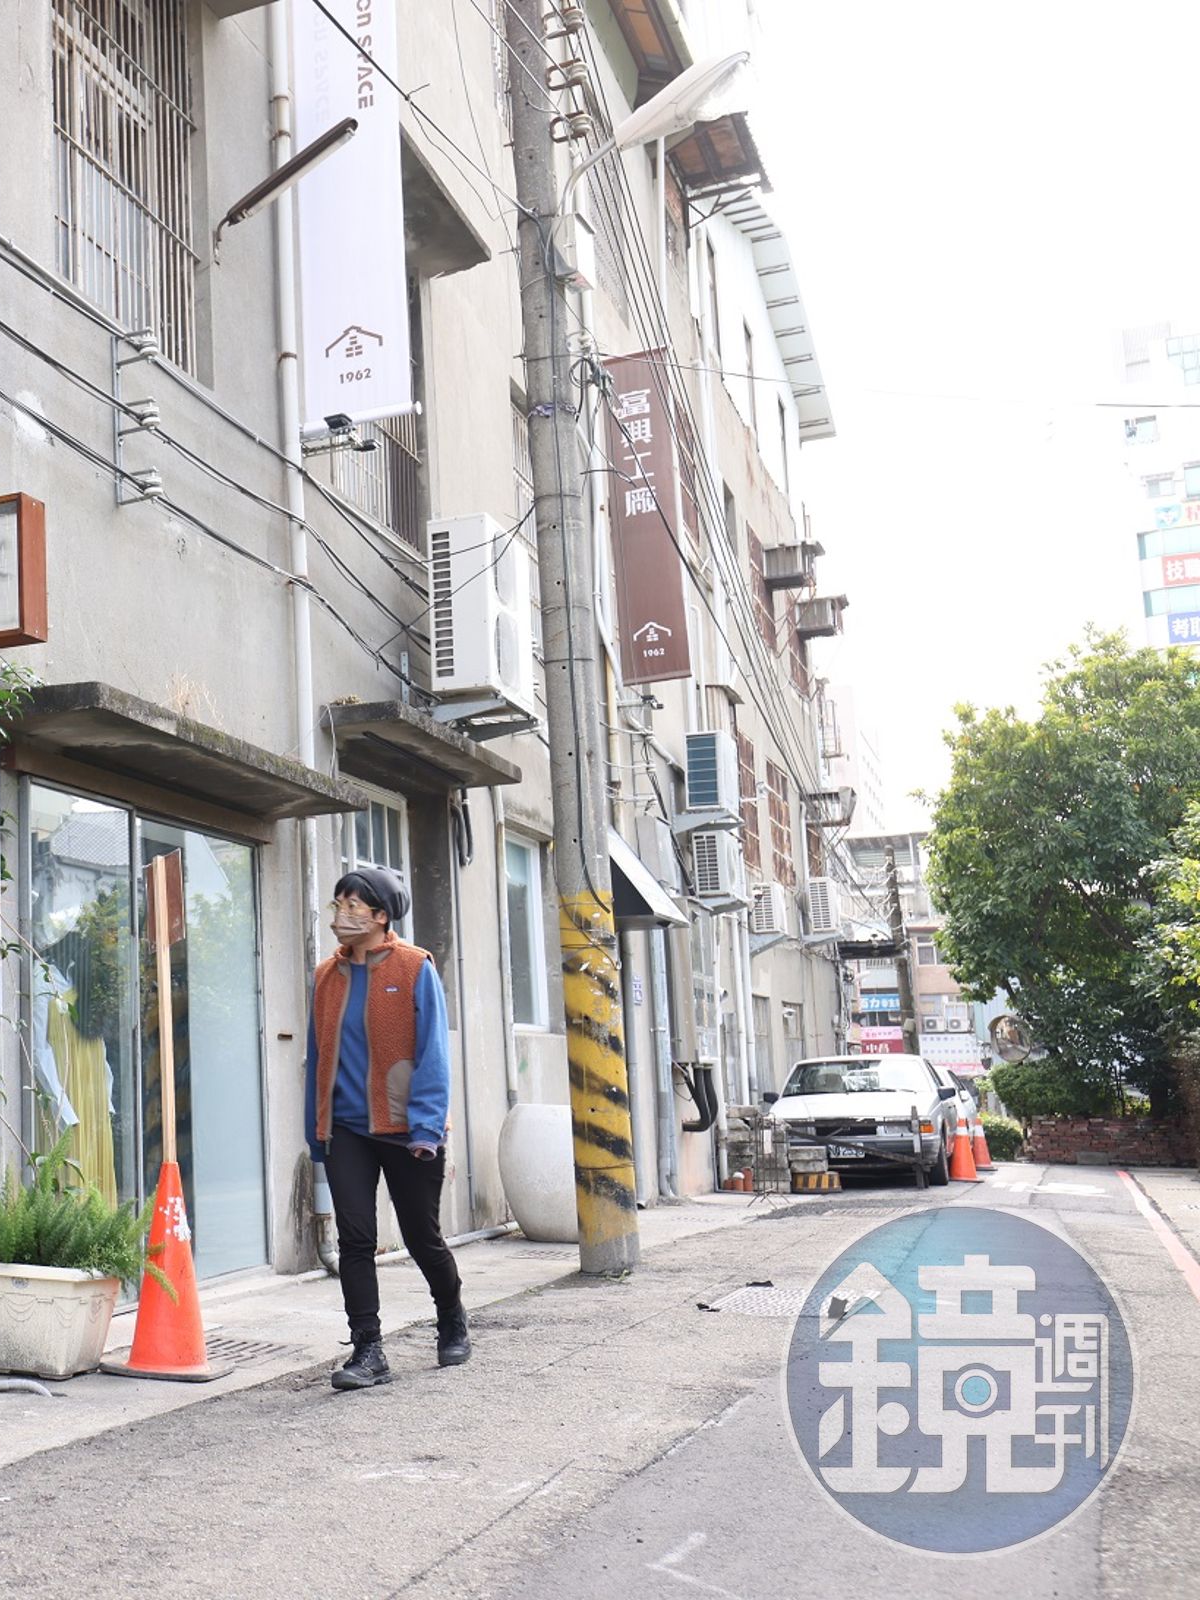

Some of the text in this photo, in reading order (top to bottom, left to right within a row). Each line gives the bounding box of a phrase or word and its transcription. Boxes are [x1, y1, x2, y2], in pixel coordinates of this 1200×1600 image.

[357, 35, 374, 109] SPACE
[339, 368, 372, 384] 1962
[617, 388, 658, 518] 富興工廠
